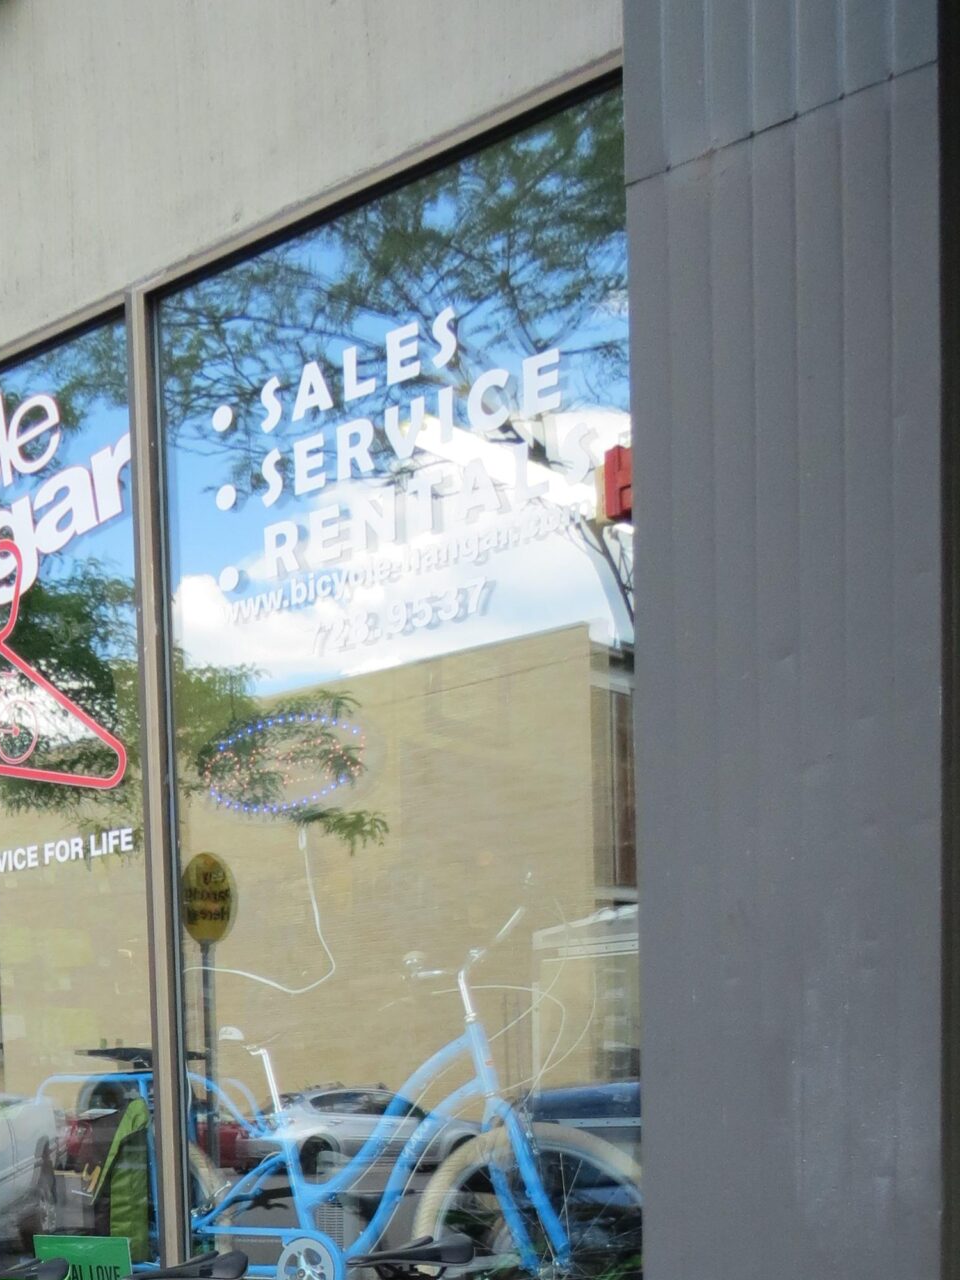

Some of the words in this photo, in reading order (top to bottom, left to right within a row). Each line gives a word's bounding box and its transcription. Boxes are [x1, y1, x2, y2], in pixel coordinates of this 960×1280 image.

[260, 306, 458, 434] SALES
[260, 348, 562, 508] SERVICE
[263, 422, 593, 577] RENTALS
[203, 735, 366, 790] OPEN
[43, 837, 84, 865] FOR
[90, 828, 133, 856] LIFE
